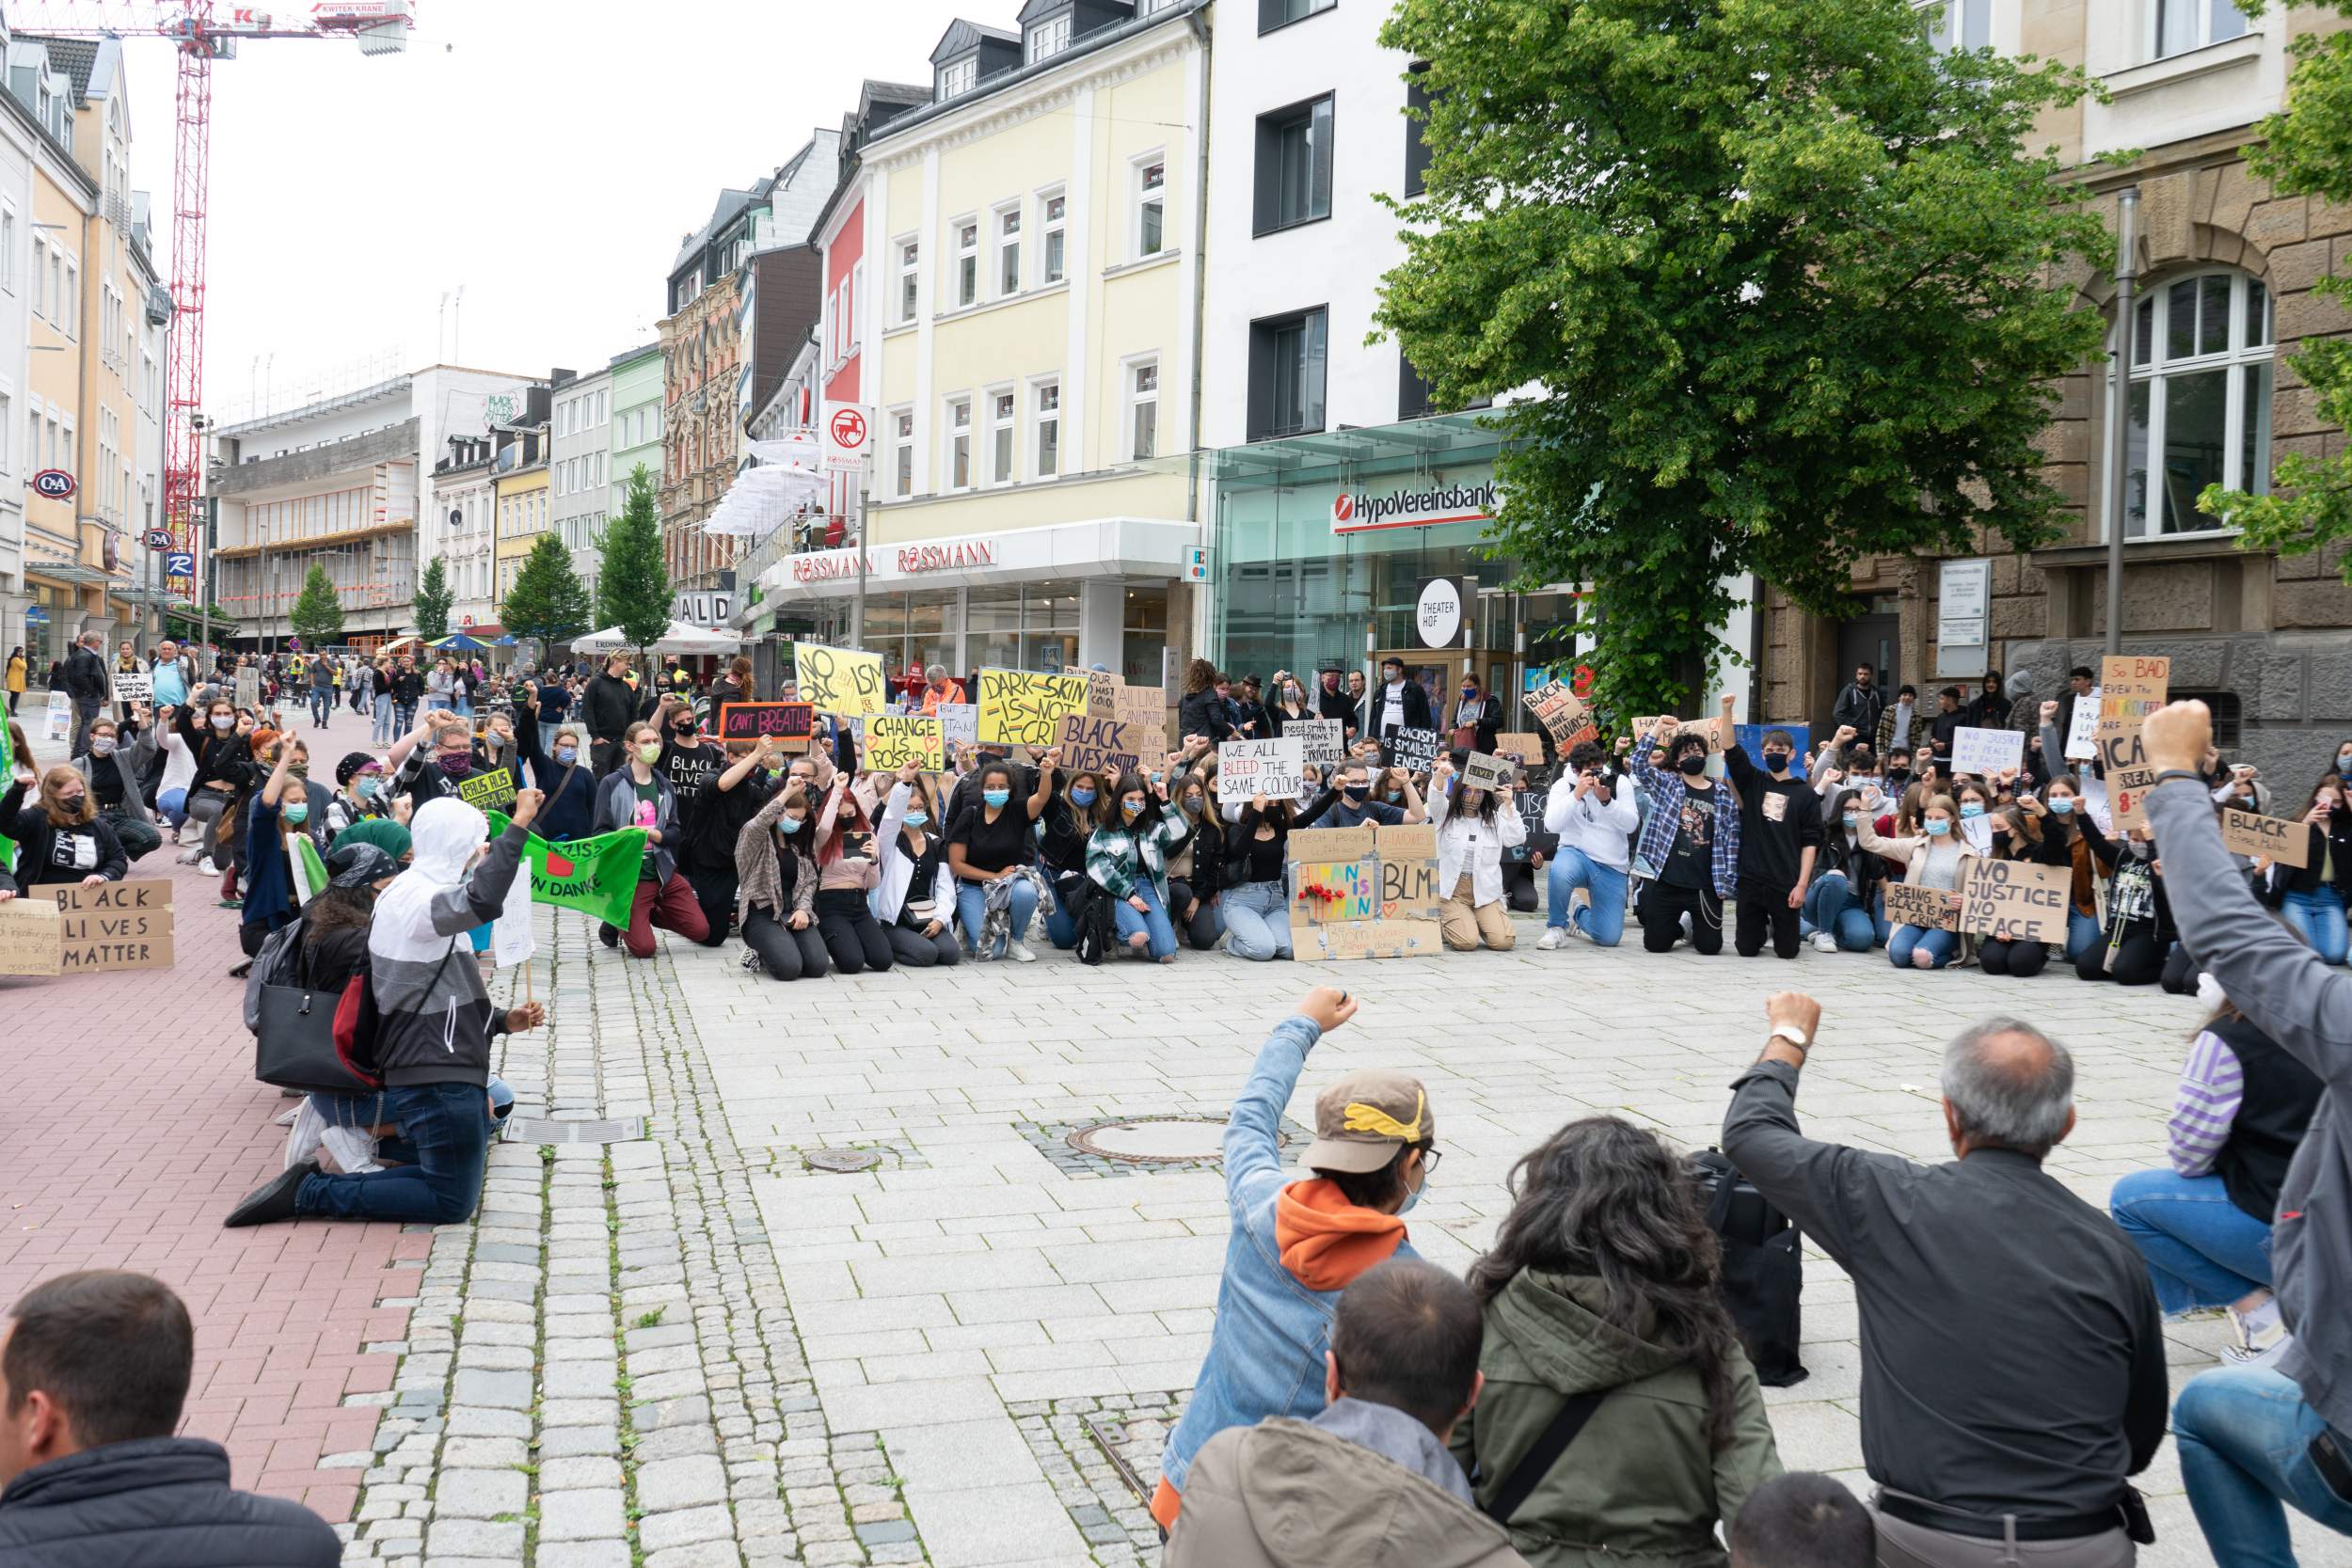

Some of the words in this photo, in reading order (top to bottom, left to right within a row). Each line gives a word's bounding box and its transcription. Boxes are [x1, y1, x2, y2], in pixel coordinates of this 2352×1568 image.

[40, 476, 69, 491] C&A
[1355, 480, 1497, 524] HypoVereinsbank
[898, 540, 992, 572] ROSSMANN
[793, 553, 873, 581] ROSSMANN
[1422, 601, 1454, 614] THEATER
[1422, 615, 1438, 627] HOF
[799, 649, 834, 683] NO
[122, 691, 152, 700] Bildung
[982, 672, 1034, 700] DARK
[1043, 675, 1089, 704] SKIN
[1526, 680, 1565, 708] BLACK
[2103, 684, 2132, 694] EVEN
[1001, 698, 1024, 721] IS
[1037, 699, 1076, 721] NOT
[1534, 696, 1565, 718] LIVES
[758, 708, 811, 734] BREATHE
[873, 717, 937, 737] CHANGE
[1284, 721, 1306, 734] need
[1329, 721, 1339, 734] to
[1546, 711, 1568, 729] HAVE
[1553, 713, 1589, 743] ALWAYS
[997, 720, 1012, 743] A
[1021, 720, 1056, 746] CRI
[1064, 715, 1128, 751] BLACK
[1384, 737, 1391, 749] IS
[1397, 726, 1437, 744] RACISM
[1964, 730, 1980, 741] NO
[893, 737, 910, 752] IS
[1225, 744, 1247, 758] WE
[1253, 741, 1280, 757] ALL
[672, 755, 712, 771] BLACK
[1059, 744, 1103, 771] LIVES
[1142, 751, 1166, 768] TER!
[1308, 749, 1343, 763] PRIVILEGE
[669, 772, 701, 785] LIVE
[1224, 760, 1259, 776] BLEED
[1263, 760, 1288, 775] THE
[462, 777, 488, 800] RAUS
[488, 771, 509, 791] AUS
[1223, 777, 1258, 795] SAME
[1262, 776, 1302, 796] COLOUR
[2231, 813, 2288, 838] BLACK
[547, 842, 603, 858] NZIS?
[1382, 863, 1432, 902] BLM
[1974, 860, 2010, 884] NO
[549, 873, 603, 898] DANKE
[1353, 879, 1371, 896] IS
[1894, 884, 1931, 904] BEING
[1967, 881, 2063, 909] JUSTICE
[56, 888, 151, 911] BLACK
[1887, 896, 1923, 916] BLACK
[1927, 905, 1936, 916] IS
[1939, 908, 1957, 922] NOT
[1968, 901, 1995, 916] NO
[66, 917, 148, 939] LIVES
[1893, 911, 1902, 924] A
[1964, 915, 2043, 942] PEACE
[62, 944, 151, 967] MATTER
